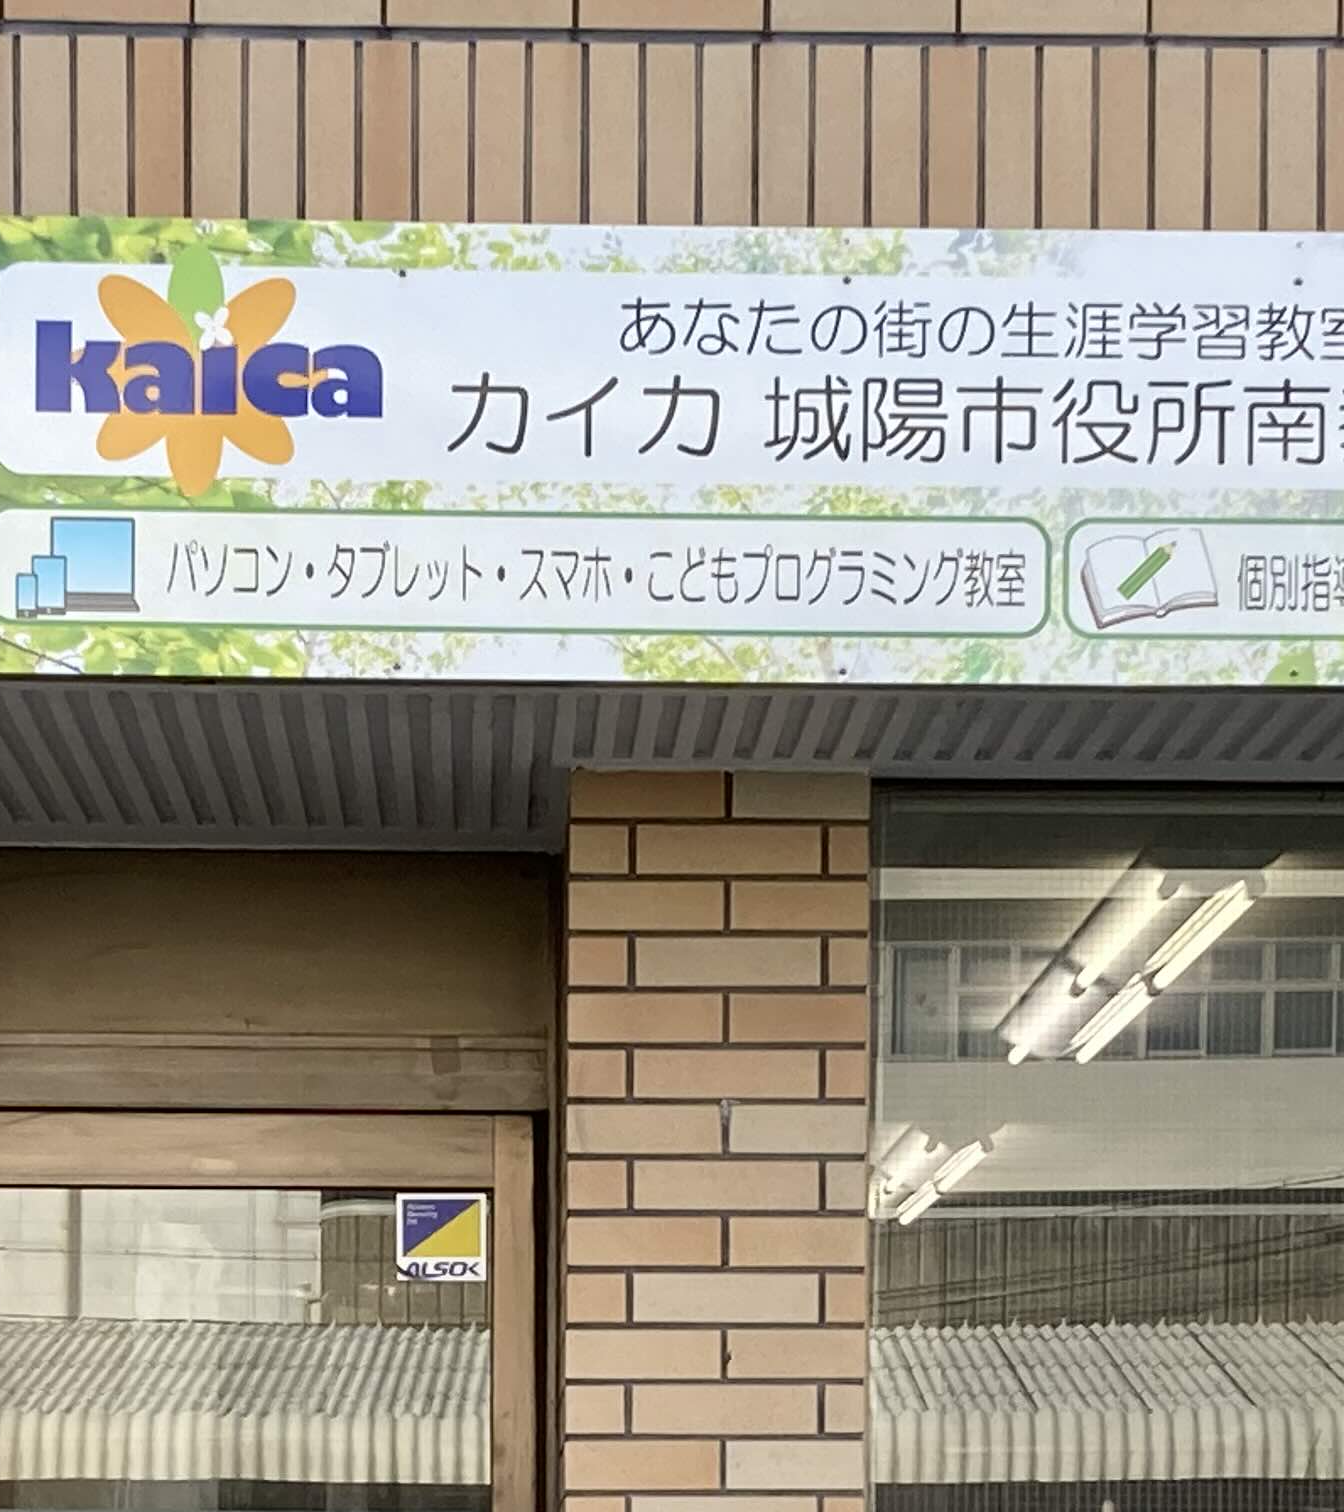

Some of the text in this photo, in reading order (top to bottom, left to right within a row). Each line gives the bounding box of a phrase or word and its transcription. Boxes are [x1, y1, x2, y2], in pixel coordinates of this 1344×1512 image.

[447, 371, 721, 459] カイカ
[406, 1261, 480, 1278] ALSOK
